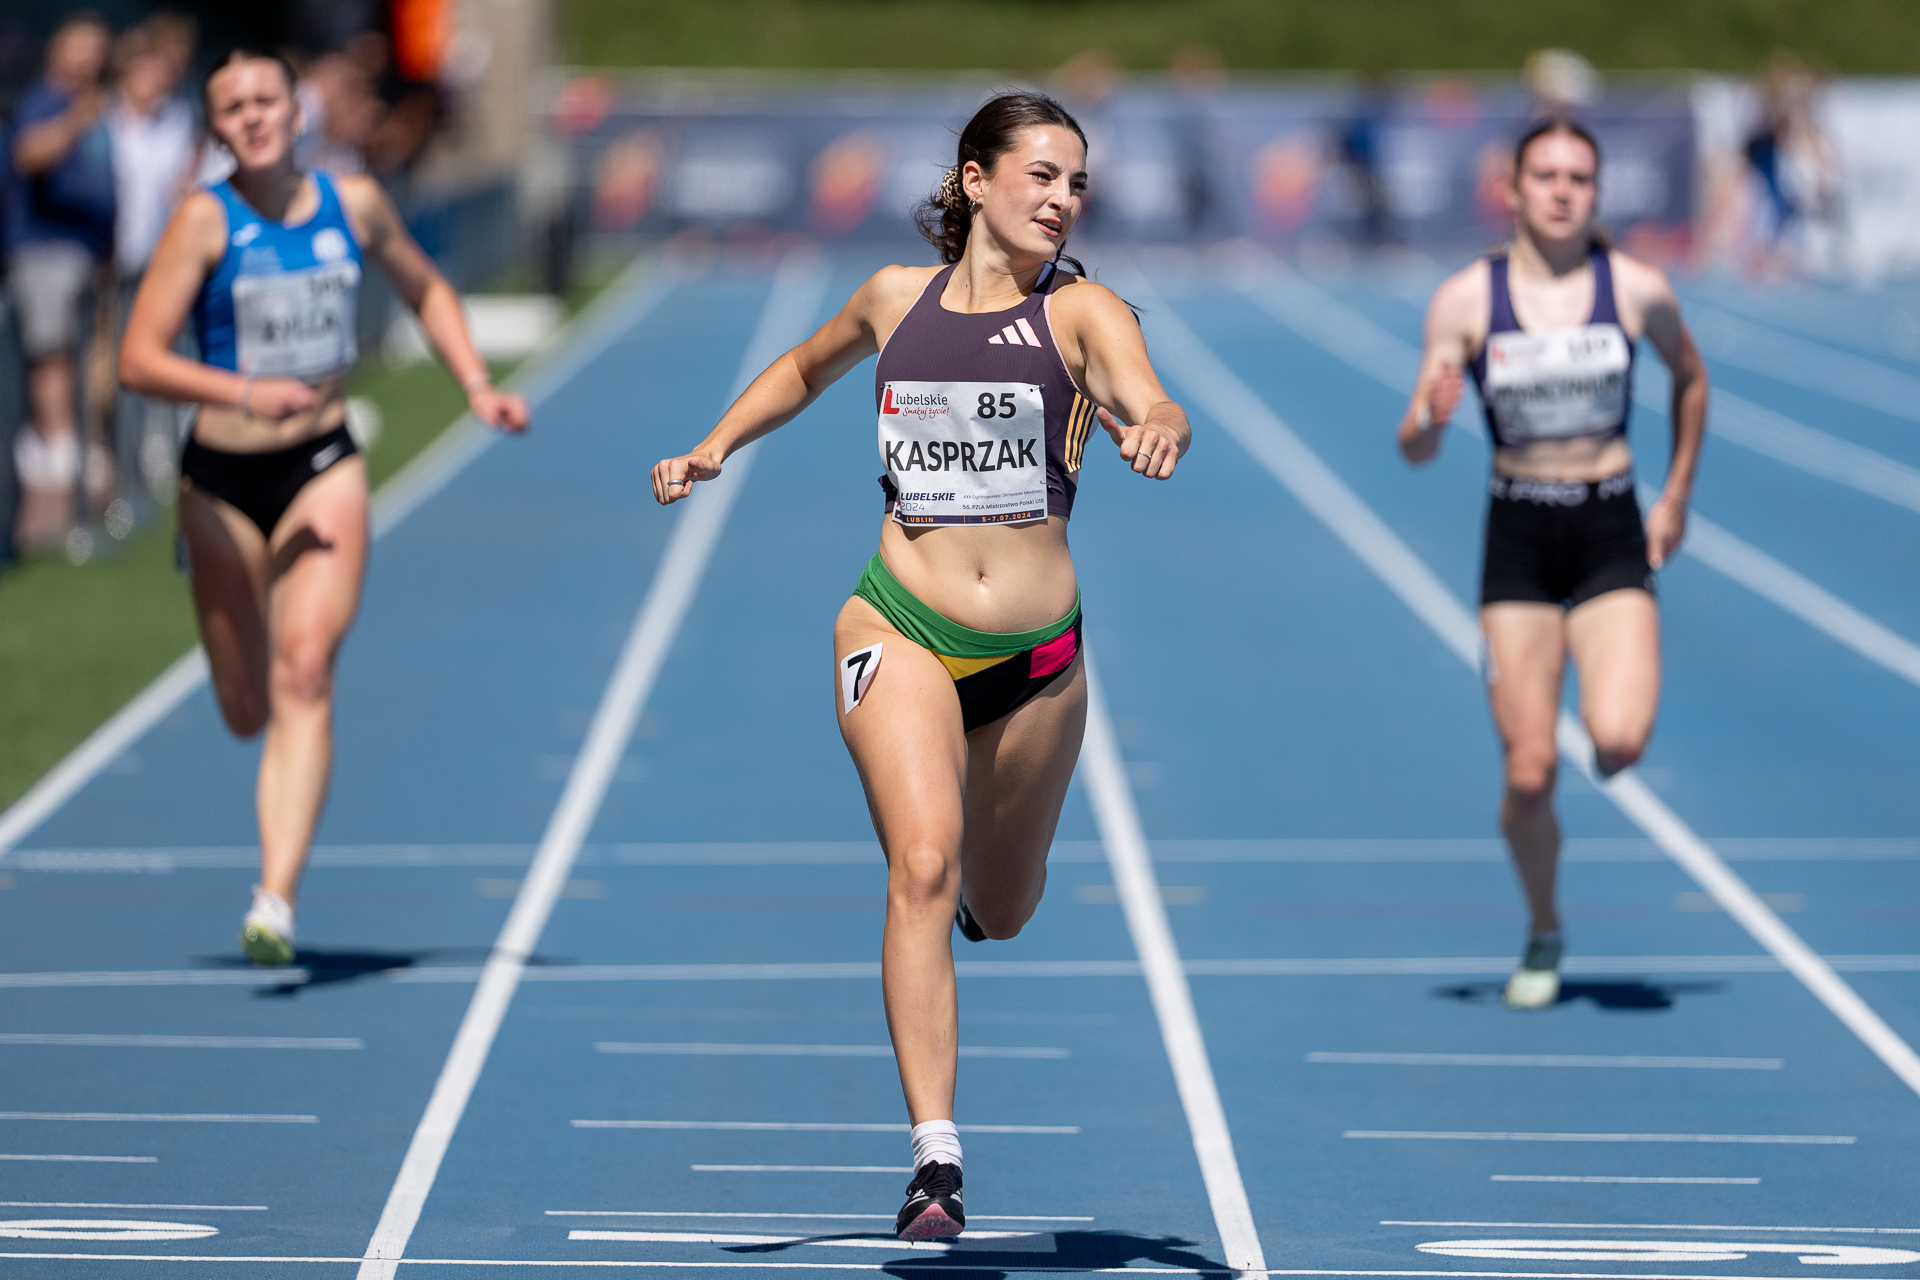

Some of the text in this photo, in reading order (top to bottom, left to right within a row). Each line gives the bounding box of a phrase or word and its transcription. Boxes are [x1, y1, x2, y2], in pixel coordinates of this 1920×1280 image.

[976, 392, 1017, 419] 85
[902, 407, 950, 420] Smakuj życie!
[885, 438, 1039, 473] KASPRZAK
[900, 492, 956, 501] LUBELSKIE
[901, 502, 925, 511] 2024
[986, 501, 1018, 509] Mistrzostwa
[981, 512, 1031, 523] 5-7.07.2024
[847, 650, 872, 703] 7
